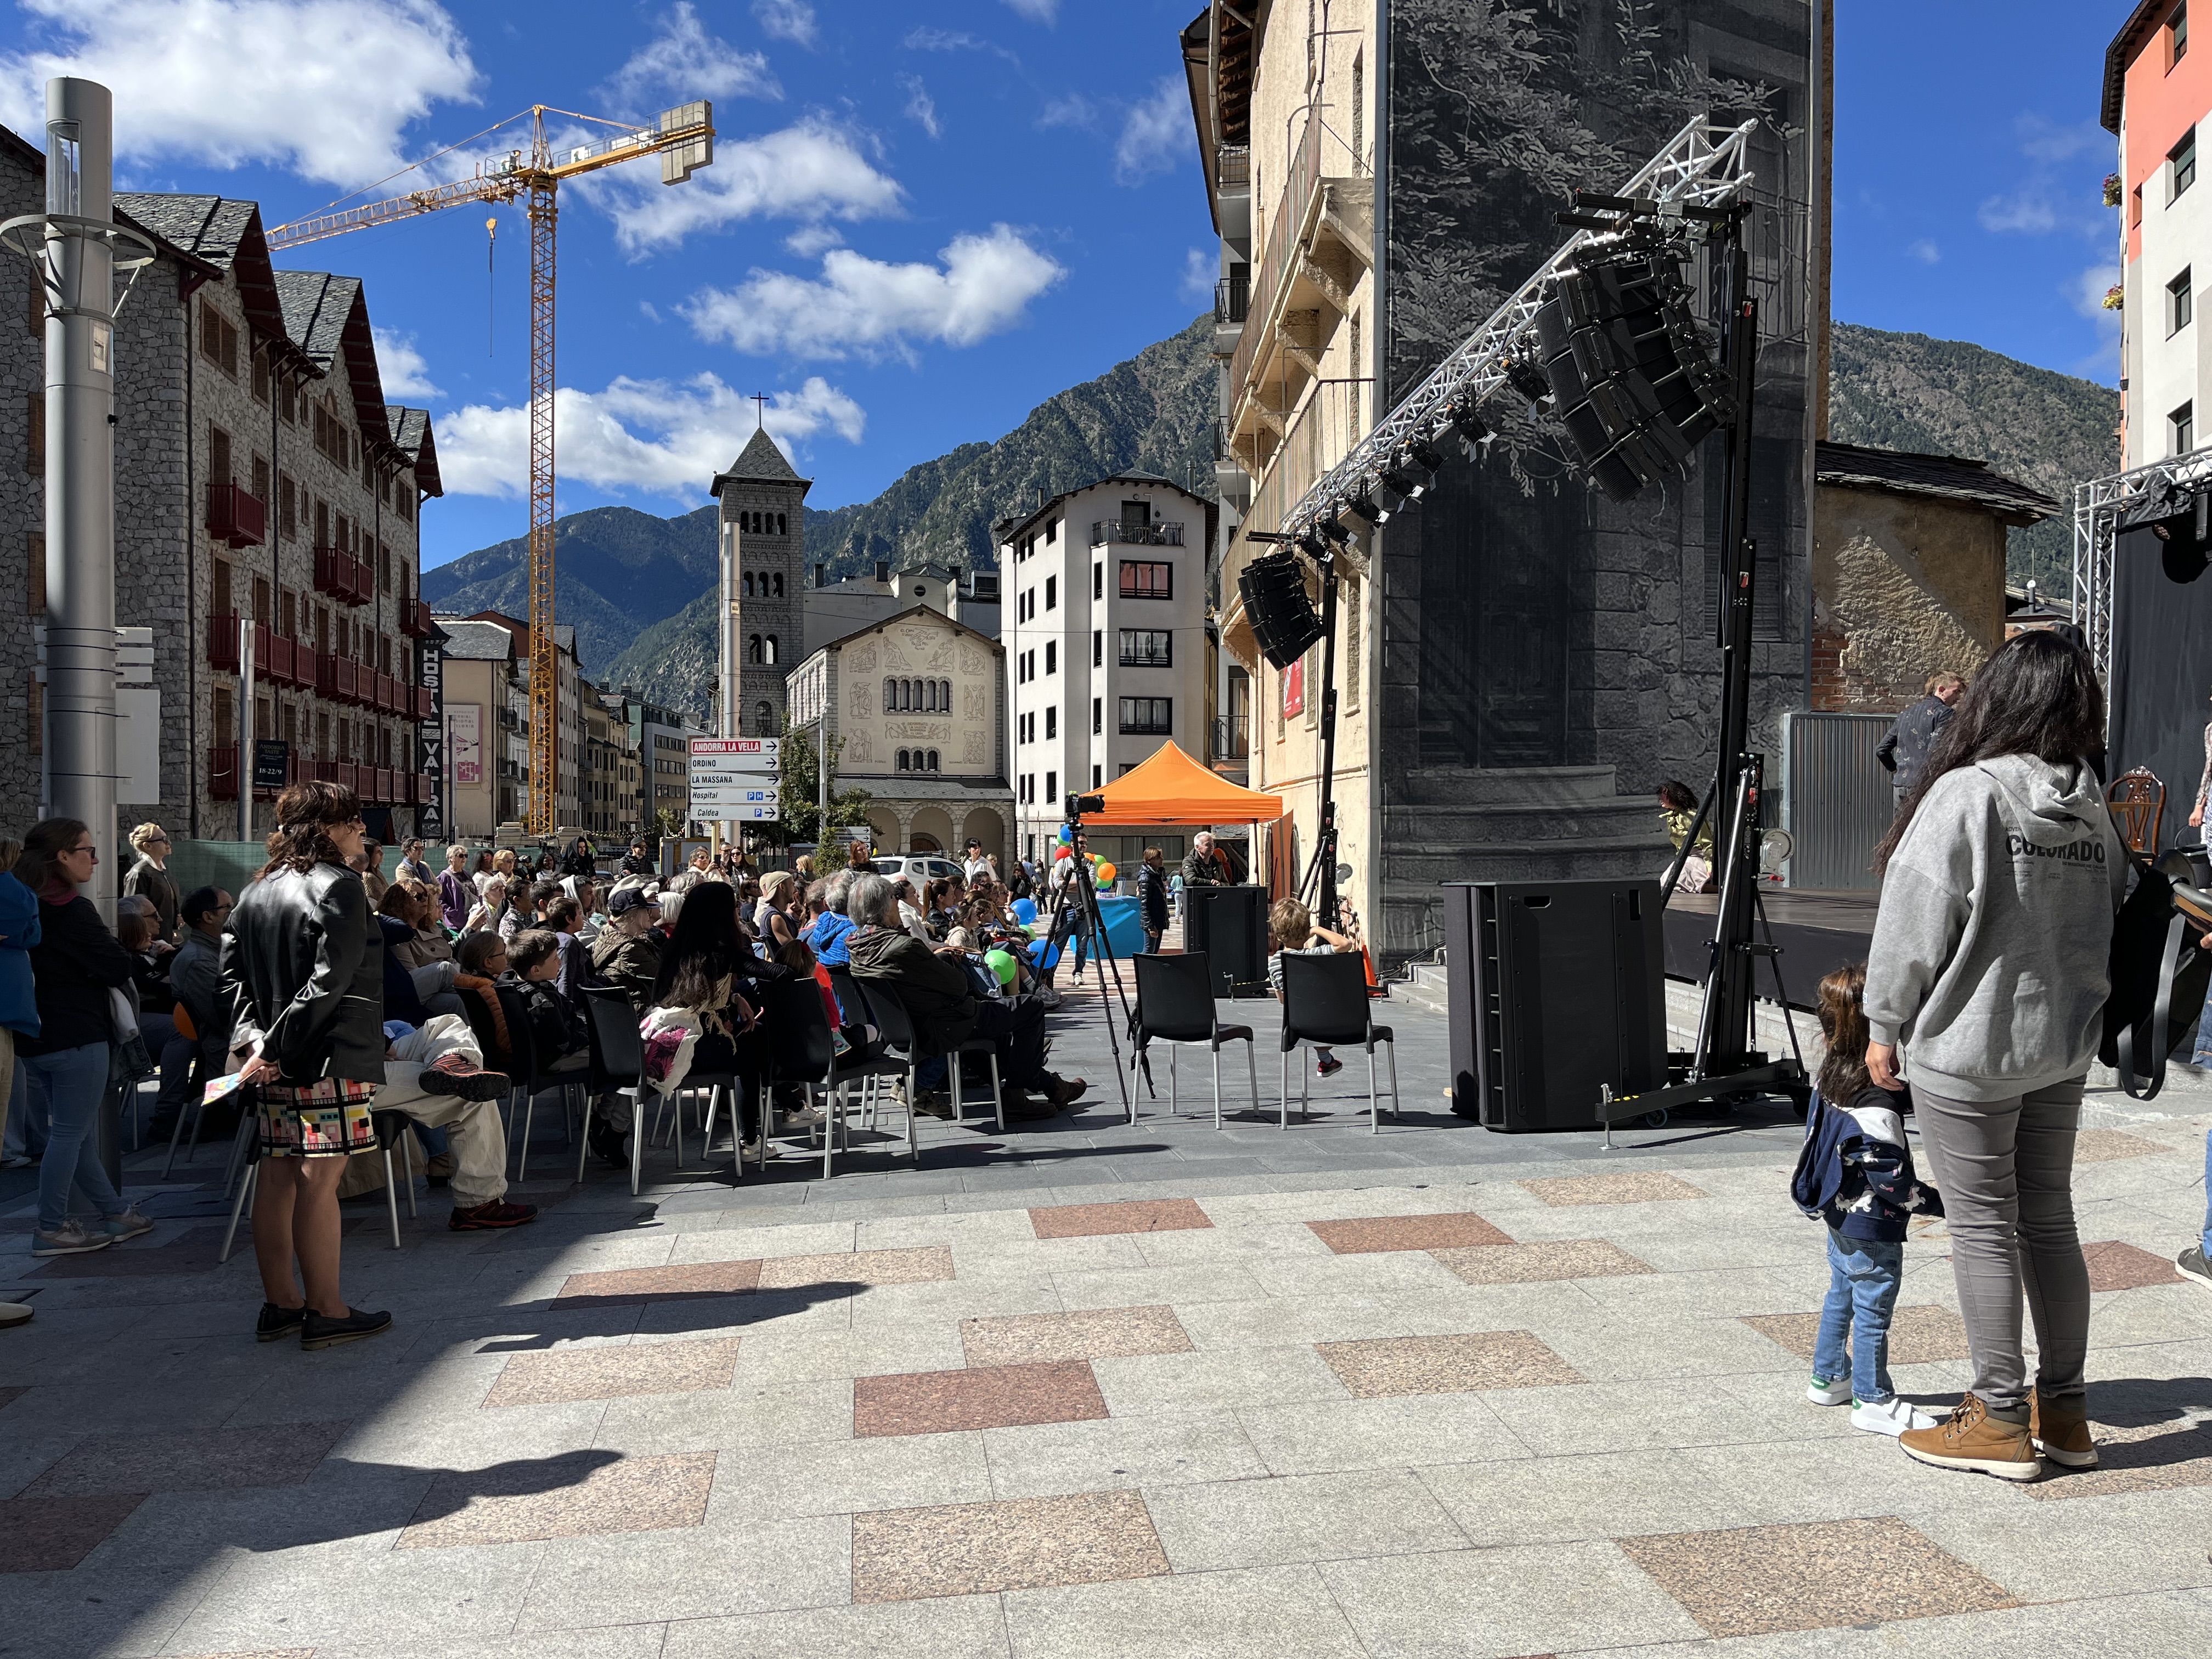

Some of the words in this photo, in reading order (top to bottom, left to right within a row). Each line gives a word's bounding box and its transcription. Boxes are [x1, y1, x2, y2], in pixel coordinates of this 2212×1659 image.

[424, 650, 438, 726] HOSTAL
[693, 742, 726, 752] ANDORRA
[728, 742, 736, 751] LA
[738, 742, 759, 751] VELLA
[692, 791, 718, 800] Hospital
[2006, 834, 2106, 864] COLORADO
